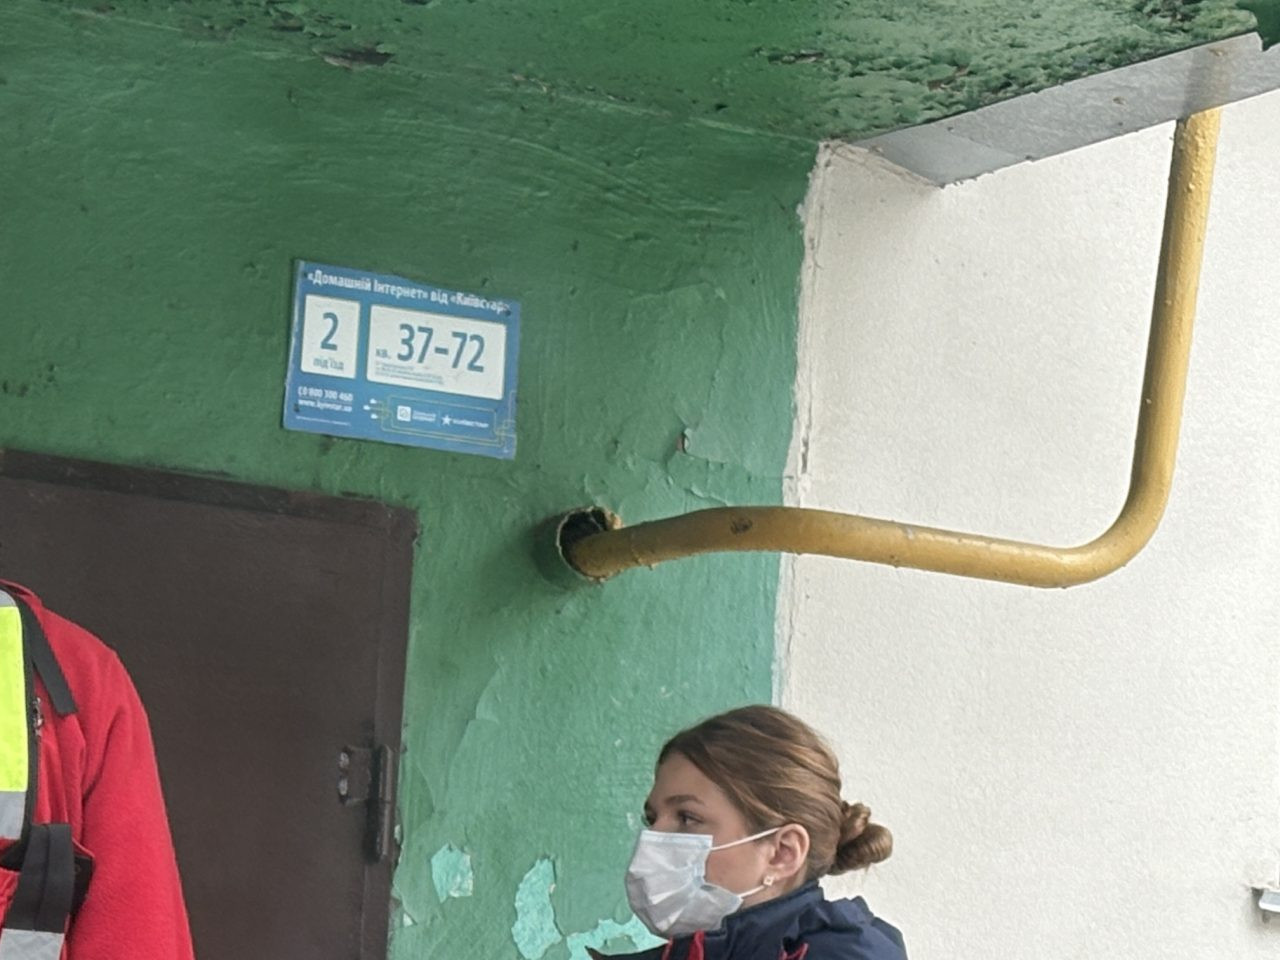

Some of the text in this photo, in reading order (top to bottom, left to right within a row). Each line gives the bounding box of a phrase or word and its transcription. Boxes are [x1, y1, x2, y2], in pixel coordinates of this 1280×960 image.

[307, 268, 372, 291] «Домашній
[373, 279, 429, 300] Інтернет»
[430, 288, 449, 306] від
[320, 312, 339, 351] 2
